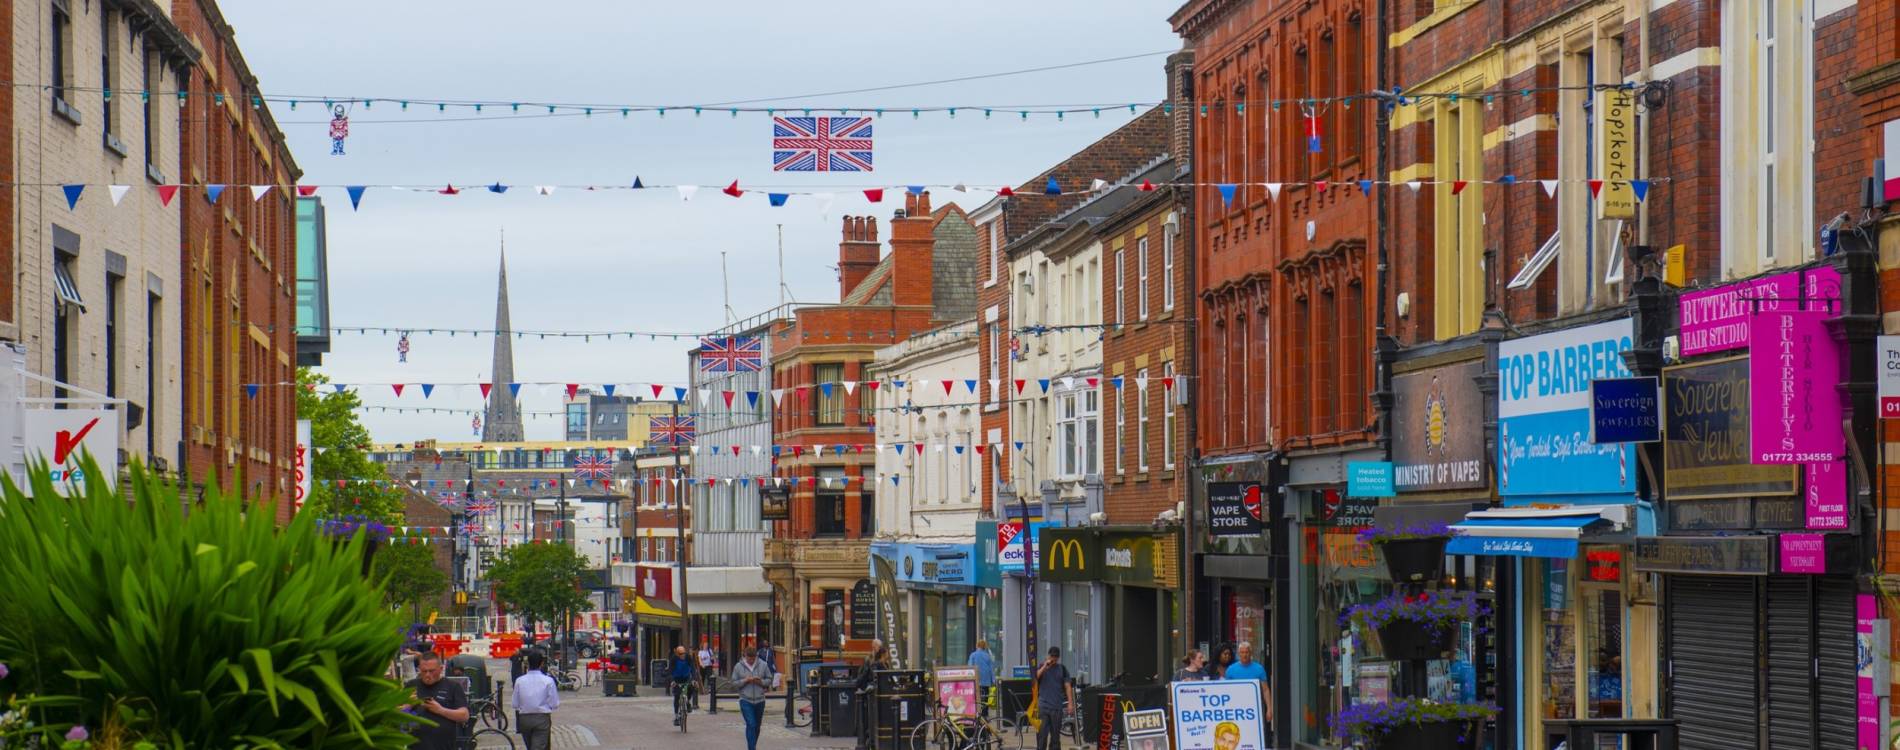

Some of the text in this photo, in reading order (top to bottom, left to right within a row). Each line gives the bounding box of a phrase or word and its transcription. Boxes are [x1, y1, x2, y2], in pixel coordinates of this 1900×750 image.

[1606, 93, 1630, 191] Hopskotch
[1683, 321, 1748, 351] HAIR STUDIO
[1500, 336, 1633, 401] TOP BARBERS
[1780, 315, 1794, 450] BUTTERFLY'S
[1596, 393, 1654, 413] Sovereign
[1675, 370, 1750, 421] Sovereig
[1763, 453, 1832, 461] 01772 334555
[1395, 460, 1480, 485] MINISTRY OF VAPES
[1212, 506, 1240, 516] VAPE
[1000, 524, 1011, 535] TO
[1212, 517, 1248, 527] STORE
[1004, 527, 1019, 543] LET
[1200, 695, 1230, 707] TOP
[1100, 694, 1116, 750] KRUGER
[1130, 714, 1161, 729] OPEN
[1182, 708, 1256, 722] BARBERS
